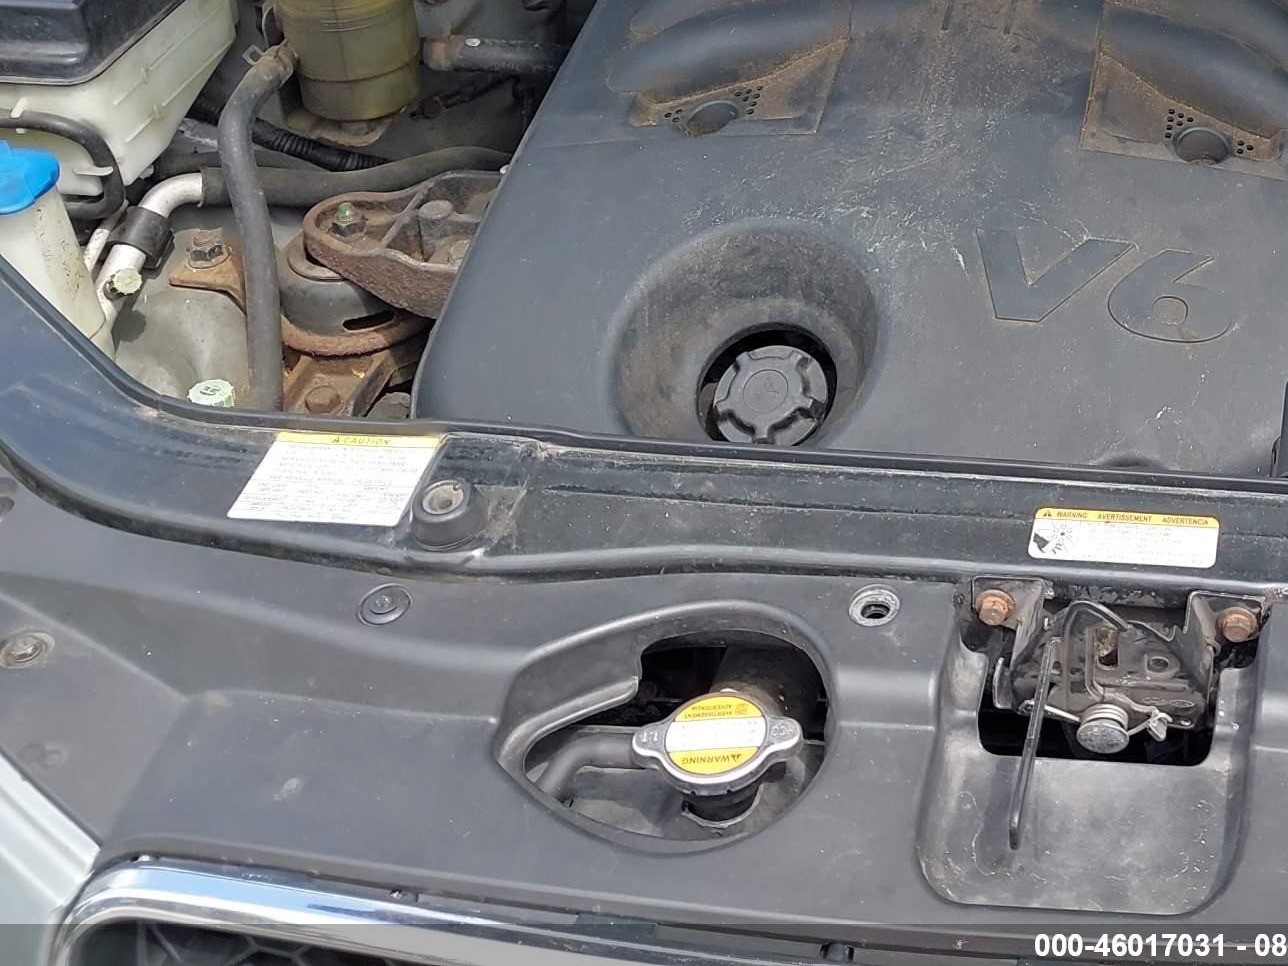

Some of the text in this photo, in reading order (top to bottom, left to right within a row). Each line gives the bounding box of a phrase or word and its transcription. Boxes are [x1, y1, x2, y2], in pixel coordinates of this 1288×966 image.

[975, 227, 1237, 344] V6
[343, 436, 390, 445] CAUTION
[1056, 511, 1209, 526] WARNING AVERTISSEMENT ADVERTENCIA
[681, 754, 732, 765] WARNING
